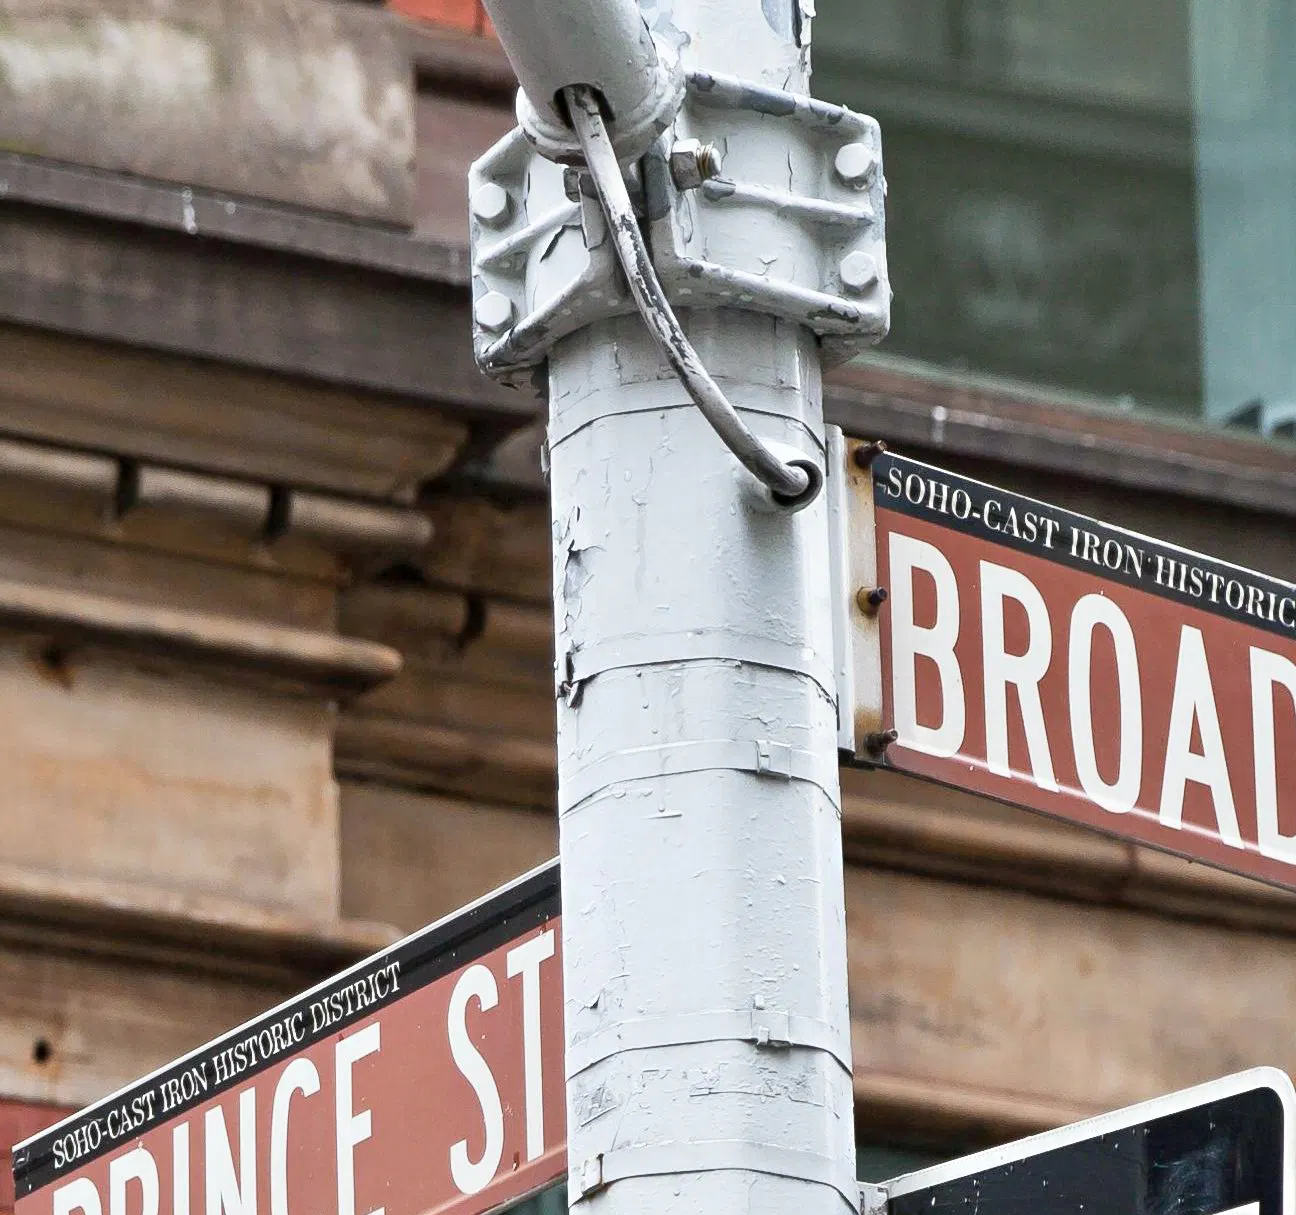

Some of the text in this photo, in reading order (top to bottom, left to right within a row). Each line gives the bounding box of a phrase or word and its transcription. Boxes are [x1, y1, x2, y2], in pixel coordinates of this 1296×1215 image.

[887, 467, 1059, 549] SOHO-CAST
[1069, 526, 1145, 579] IRON
[1154, 554, 1296, 628] HISTORIC
[52, 961, 401, 1169] SOHO-CAST IRON HISTORIC DISTRICT
[447, 929, 555, 1195] ST
